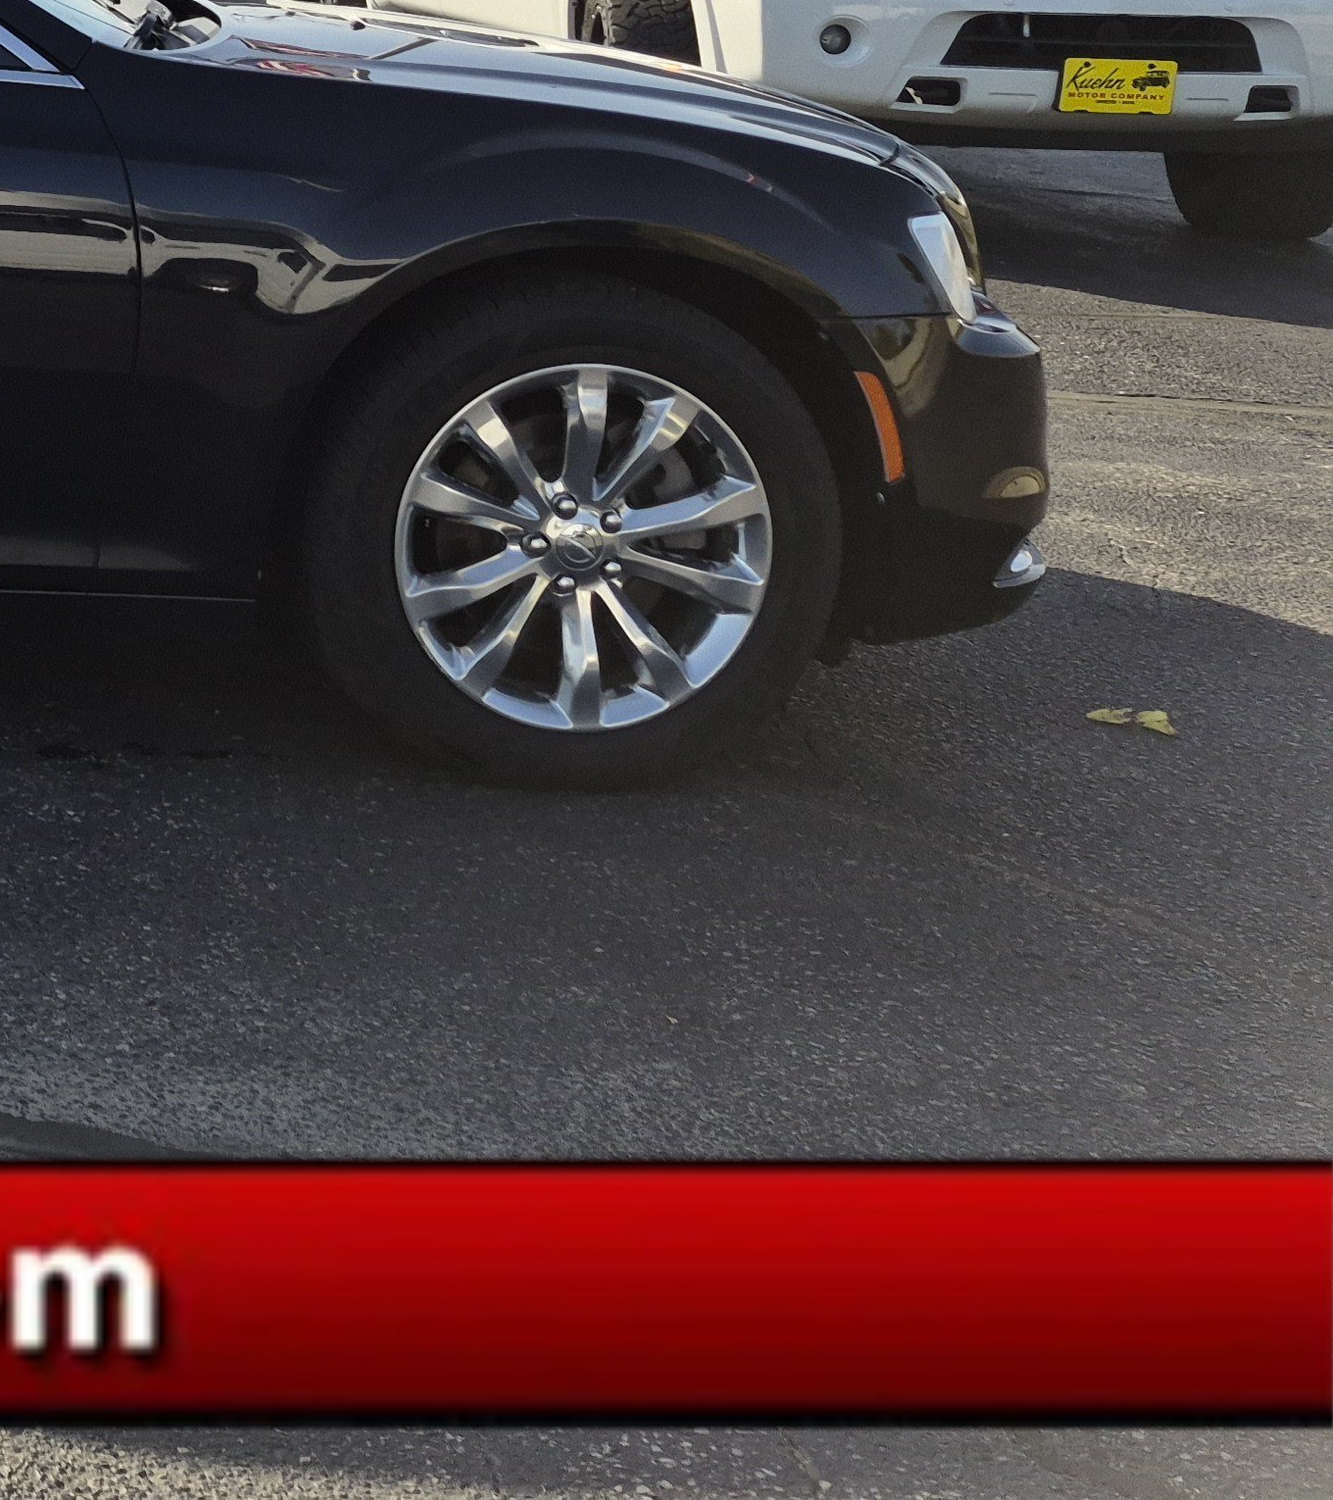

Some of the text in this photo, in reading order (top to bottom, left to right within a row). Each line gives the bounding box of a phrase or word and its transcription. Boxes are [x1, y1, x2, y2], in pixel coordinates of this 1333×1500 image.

[1065, 65, 1126, 92] Kuehn
[1067, 91, 1165, 101] MOTOR COMPANY
